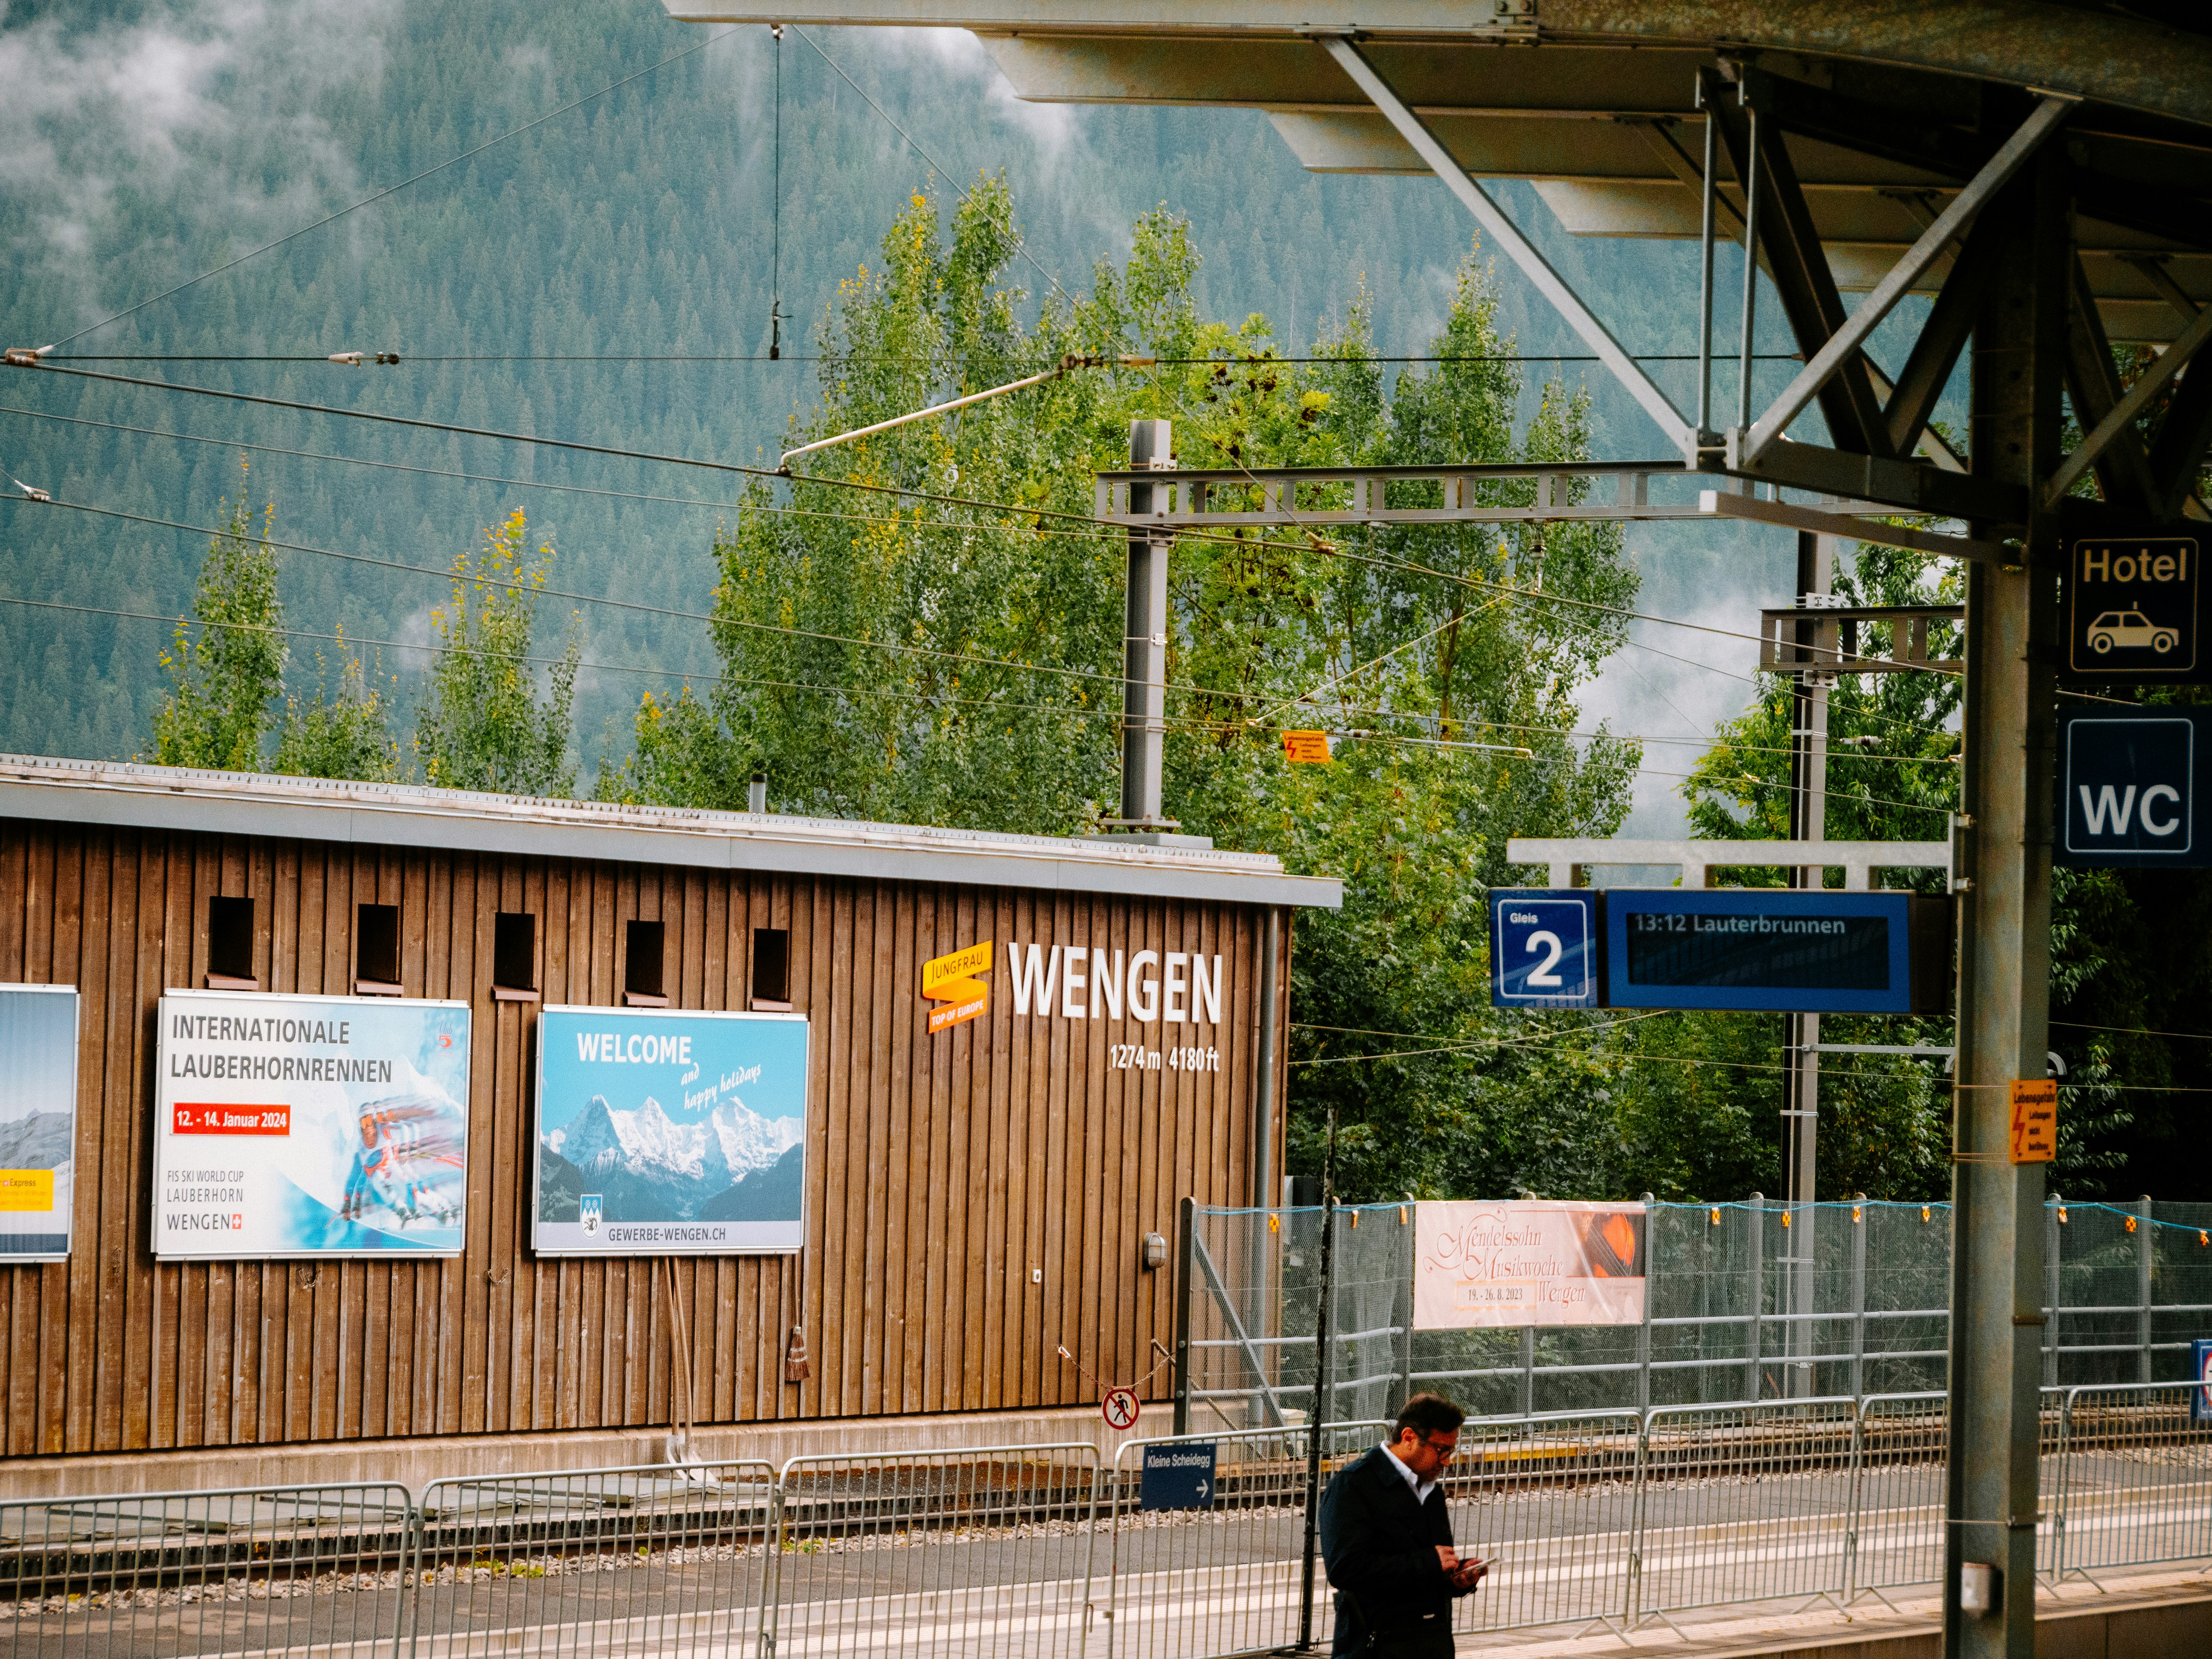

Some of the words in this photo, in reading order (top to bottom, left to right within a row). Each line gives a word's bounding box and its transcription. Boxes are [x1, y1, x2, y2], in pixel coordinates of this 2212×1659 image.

[2083, 548, 2187, 582] Hotel
[2078, 784, 2180, 835] WC
[1509, 911, 1538, 925] Gleis
[1634, 914, 1686, 932] 13:12
[1693, 914, 1846, 934] Lauterbrunnen
[1525, 929, 1563, 987] 2
[1008, 942, 1222, 1024] WENGEN
[931, 1013, 946, 1027] TOP
[947, 1009, 956, 1022] OF
[957, 999, 984, 1018] EUROPE
[173, 1014, 349, 1044] INTERNATIONALE
[577, 1033, 692, 1064] WELCOME
[171, 1054, 392, 1083] LAUBERHORNRENNEN
[681, 1062, 700, 1085] and
[684, 1086, 717, 1111] happy
[720, 1064, 762, 1094] holidays
[177, 1110, 193, 1126] 12.
[204, 1111, 220, 1127] 14.
[222, 1112, 259, 1128] Januar
[261, 1112, 287, 1128] 2024
[10, 1178, 36, 1188] Express
[167, 1170, 179, 1182] FIS
[181, 1170, 195, 1182] SKI
[196, 1170, 225, 1182] WORLD
[228, 1171, 244, 1182] CUP
[167, 1188, 243, 1203] LAUBERHORN
[166, 1214, 230, 1230] WENGEN
[608, 1228, 726, 1241] GEWERBE-WENGEN.CH
[1427, 1209, 1541, 1269] Mendelssohn
[1463, 1248, 1563, 1280] Musikwoche
[1468, 1289, 1478, 1301] 19.
[1485, 1289, 1496, 1300] 26.
[1497, 1289, 1505, 1300] 8.
[1506, 1288, 1522, 1300] 2023
[1538, 1280, 1585, 1309] Wengen
[1148, 1455, 1170, 1468] Kleine
[1172, 1453, 1210, 1468] Scheidegg
